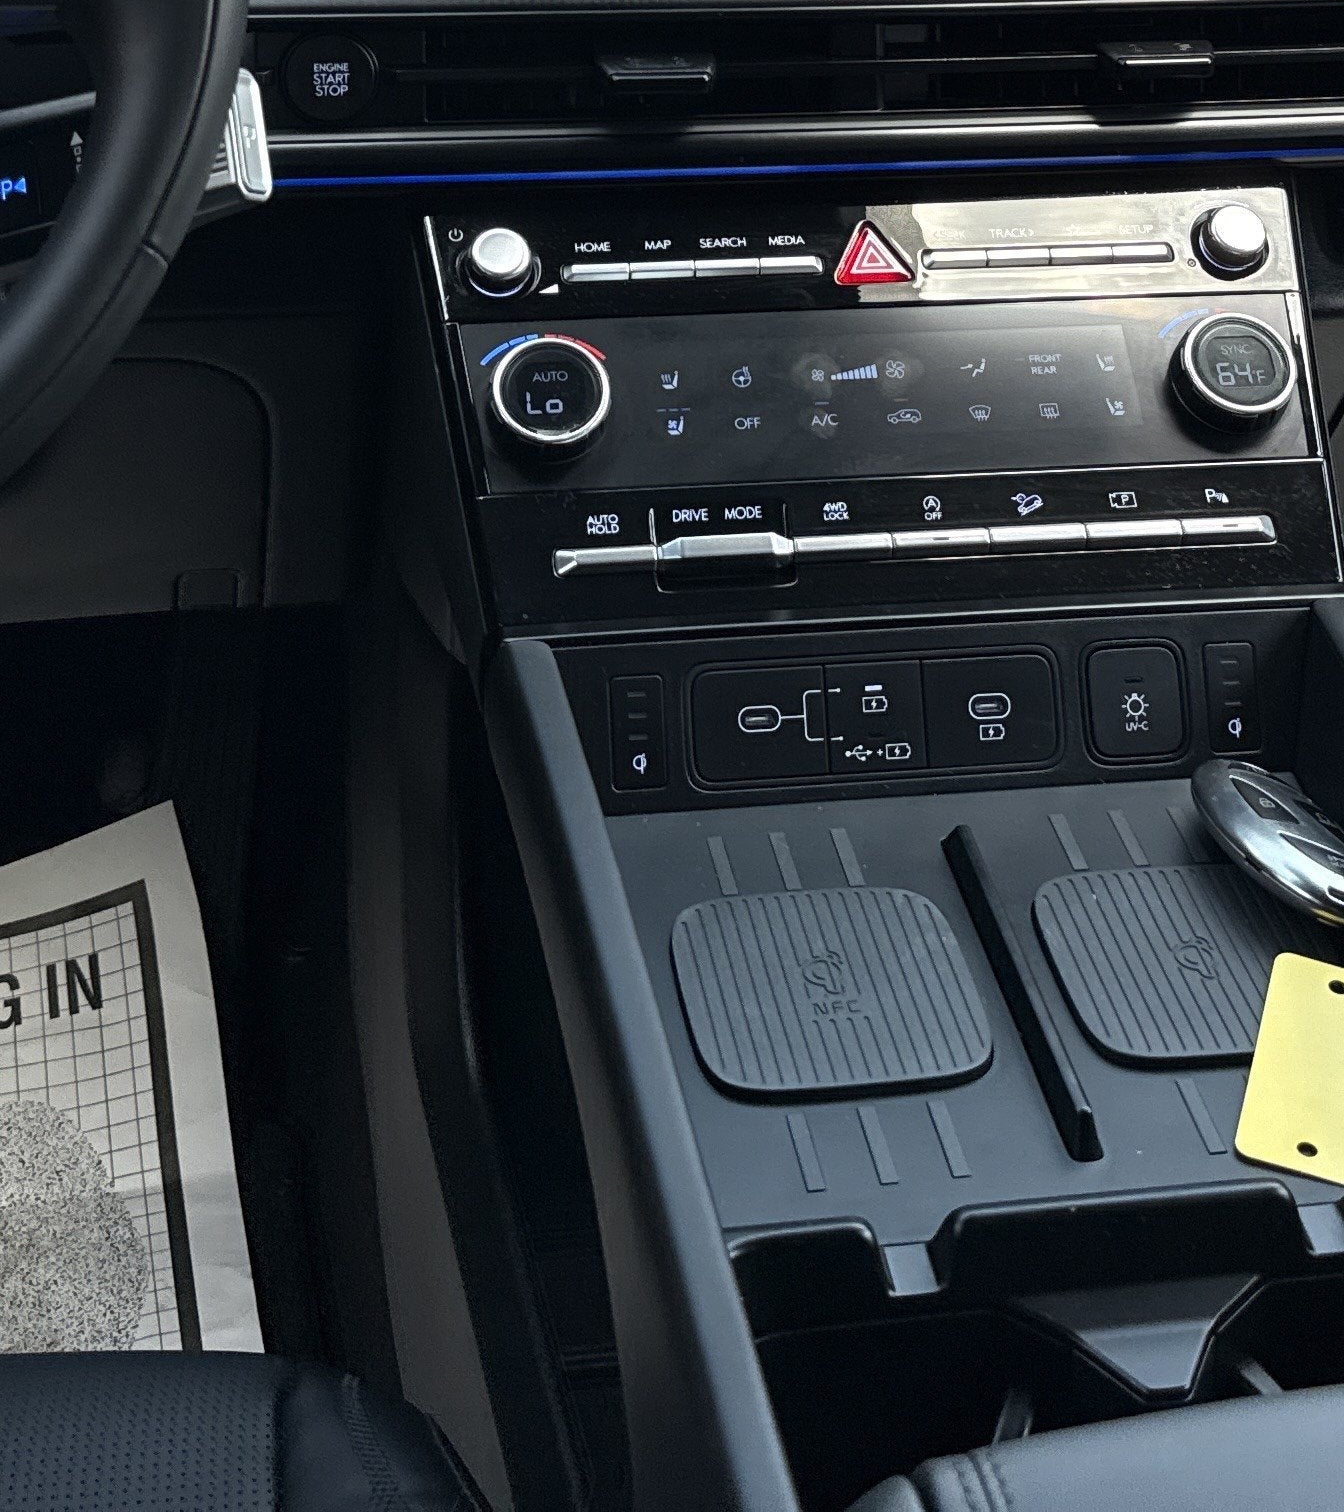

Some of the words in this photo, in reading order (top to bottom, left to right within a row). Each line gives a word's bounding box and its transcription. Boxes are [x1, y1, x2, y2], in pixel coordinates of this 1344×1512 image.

[313, 62, 349, 72] ENGINE
[313, 73, 350, 84] START
[315, 85, 349, 96] STOP
[0, 179, 13, 201] P
[574, 241, 611, 253] HOME
[644, 240, 671, 250] MAP
[699, 237, 747, 249] SEARCH
[768, 235, 805, 247] MEDIA
[1220, 344, 1252, 356] SYNC
[1028, 353, 1061, 363] FRONT
[532, 370, 568, 383] AUTO
[1031, 366, 1058, 375] REAR
[734, 417, 761, 430] OFF
[811, 413, 839, 428] A/C
[823, 501, 847, 512] 4WD
[586, 514, 618, 525] AUTO
[672, 508, 709, 522] DRIVE
[724, 505, 763, 520] MODE
[823, 509, 850, 521] LOCK
[924, 510, 943, 521] OFF
[587, 523, 620, 535] HOLD
[1126, 721, 1149, 731] UV-C
[46, 953, 103, 1019] IN
[812, 999, 861, 1015] NFC
